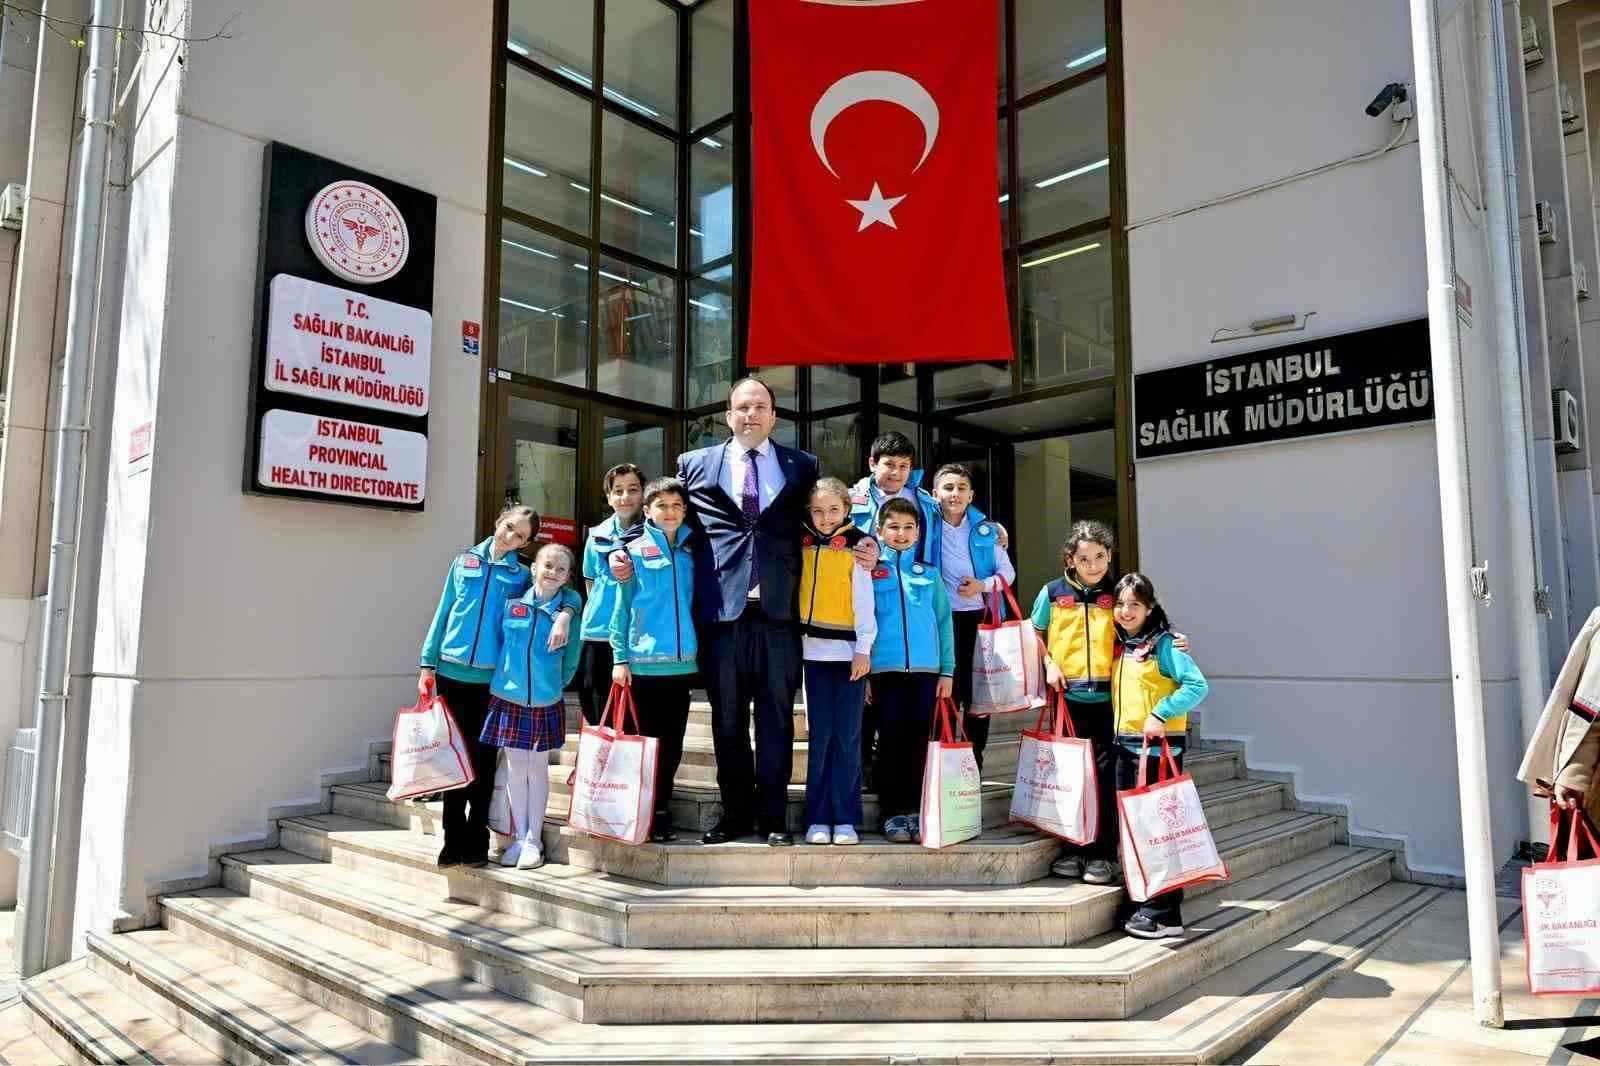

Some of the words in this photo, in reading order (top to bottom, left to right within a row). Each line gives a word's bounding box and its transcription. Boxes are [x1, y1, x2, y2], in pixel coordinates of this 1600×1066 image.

[345, 299, 370, 319] T.C.
[293, 313, 343, 339] SAĞLIK
[346, 324, 414, 355] BAKANLIĞI
[320, 342, 386, 375] İSTANBUL
[1205, 348, 1341, 397] İSTANBUL
[274, 359, 289, 382] İL
[291, 367, 342, 392] SAĞLIK
[344, 375, 424, 407] MÜDÜRLÜĞÜ
[1139, 408, 1232, 447] SAĞLIK
[1244, 370, 1430, 432] MÜDÜRLÜĞÜ
[317, 419, 383, 445] ISTANBUL
[309, 445, 388, 471] PROVINCIAL
[271, 466, 327, 489] HEALTH
[331, 474, 418, 500] DIRECTORATE
